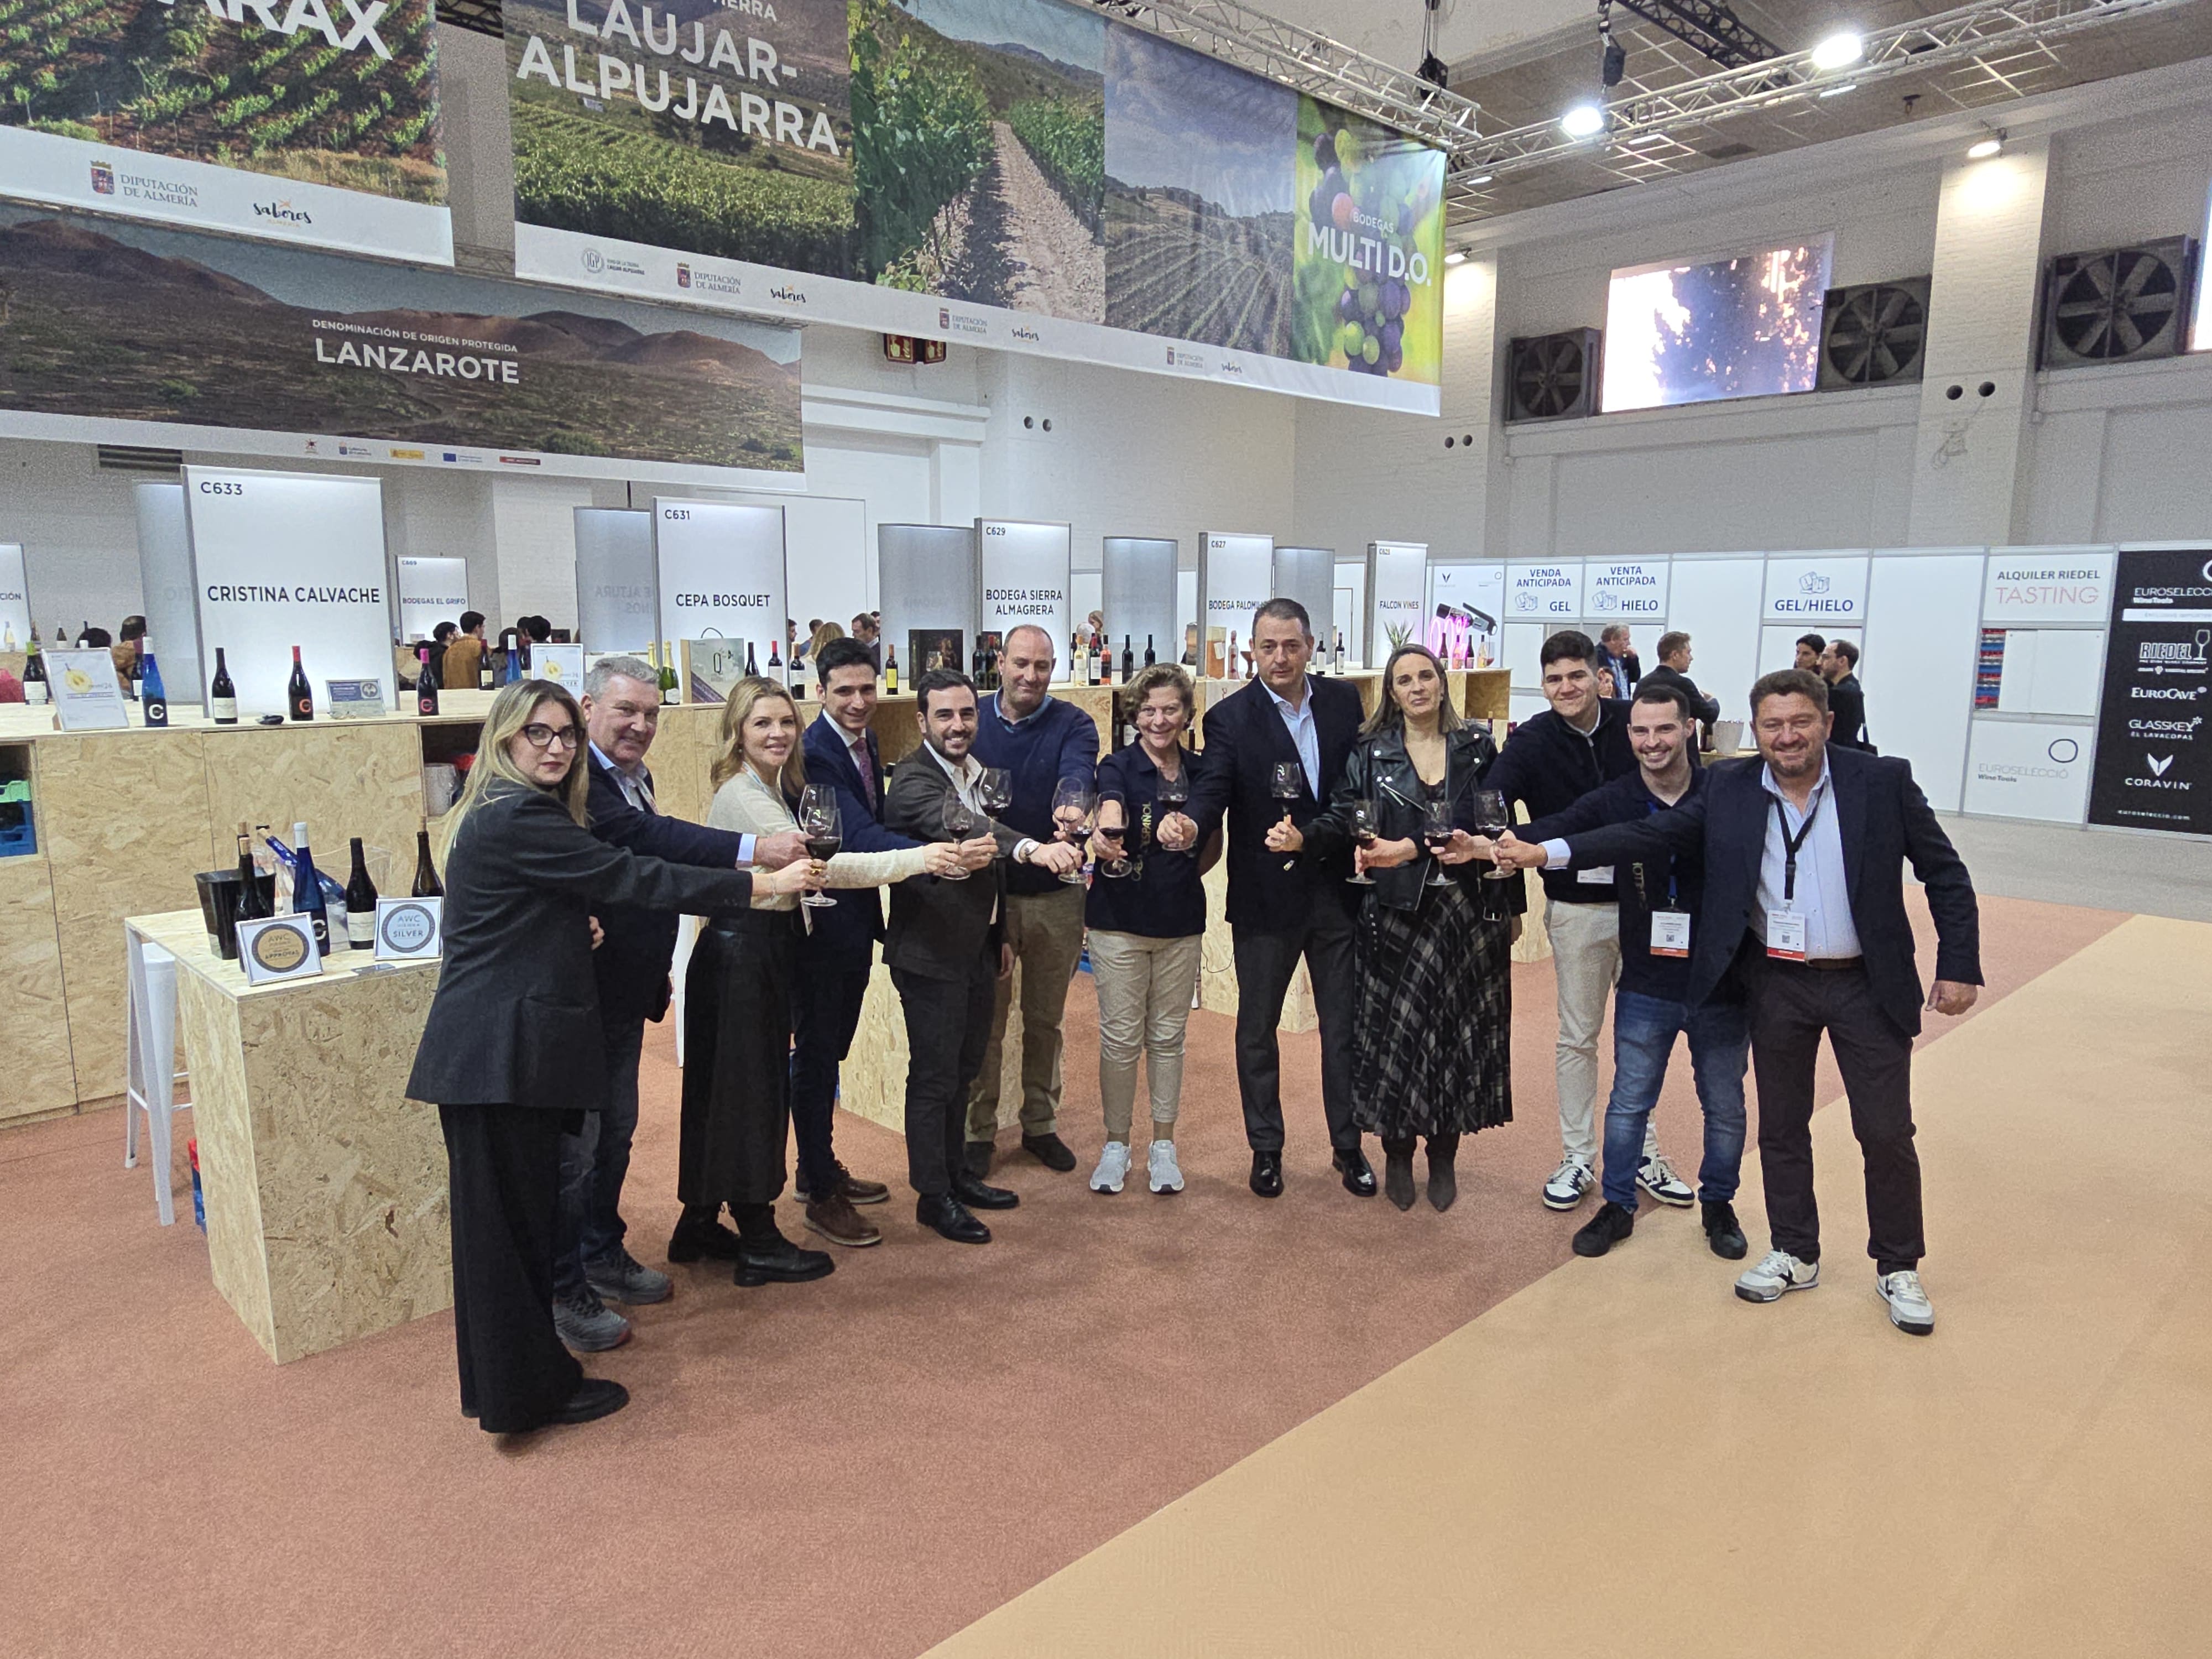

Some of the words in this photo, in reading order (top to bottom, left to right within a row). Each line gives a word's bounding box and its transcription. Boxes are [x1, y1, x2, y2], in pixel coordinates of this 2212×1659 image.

[517, 35, 839, 156] ALPUJARRA
[121, 174, 198, 195] DIPUTACIÓN
[123, 186, 140, 197] DE
[143, 191, 198, 207] ALMERÍA
[1353, 211, 1394, 234] BODEGAS
[1307, 221, 1382, 274] MULTI
[1388, 244, 1431, 287] D.O.
[694, 270, 741, 286] DIPUTACIÓN
[696, 280, 706, 289] DE
[708, 283, 741, 295] ALMERÍA
[312, 319, 400, 338] DENOMINACIÓN
[402, 331, 417, 341] DE
[419, 333, 460, 347] ORIGEN
[461, 338, 519, 353] PROTEGIDA
[315, 337, 520, 384] LANZAROTE
[200, 481, 243, 496] C633
[664, 509, 691, 520] C631
[985, 526, 1006, 536] C629
[1530, 568, 1561, 577] VENDA
[1610, 566, 1642, 575] VENTA
[1997, 570, 2055, 581] ALQUILER
[2058, 569, 2101, 580] RIEDEL
[1516, 578, 1571, 587] ANTICIPADA
[1596, 576, 1656, 586] ANTICIPADA
[207, 585, 290, 602] CRISTINA
[295, 586, 380, 604] CALVACHE
[676, 593, 709, 607] CEPA
[713, 594, 771, 607] BOSQUET
[985, 589, 1027, 601] BODEGA
[1030, 589, 1063, 601] SIERRA
[1995, 586, 2100, 604] TASTING
[995, 604, 1054, 615] ALMAGRERA
[1208, 599, 1235, 610] BODEGA
[1379, 600, 1402, 609] FALCON
[1550, 601, 1571, 612] GEL
[1621, 599, 1658, 611] HIELO
[1775, 599, 1854, 612] GEL/HIELO
[2139, 642, 2192, 660] RIEDEL
[149, 704, 164, 720] C
[2128, 719, 2194, 732] GLASSKEY
[2125, 777, 2190, 790] CORAVIN
[398, 915, 421, 923] AWC
[393, 930, 424, 938] SILVER
